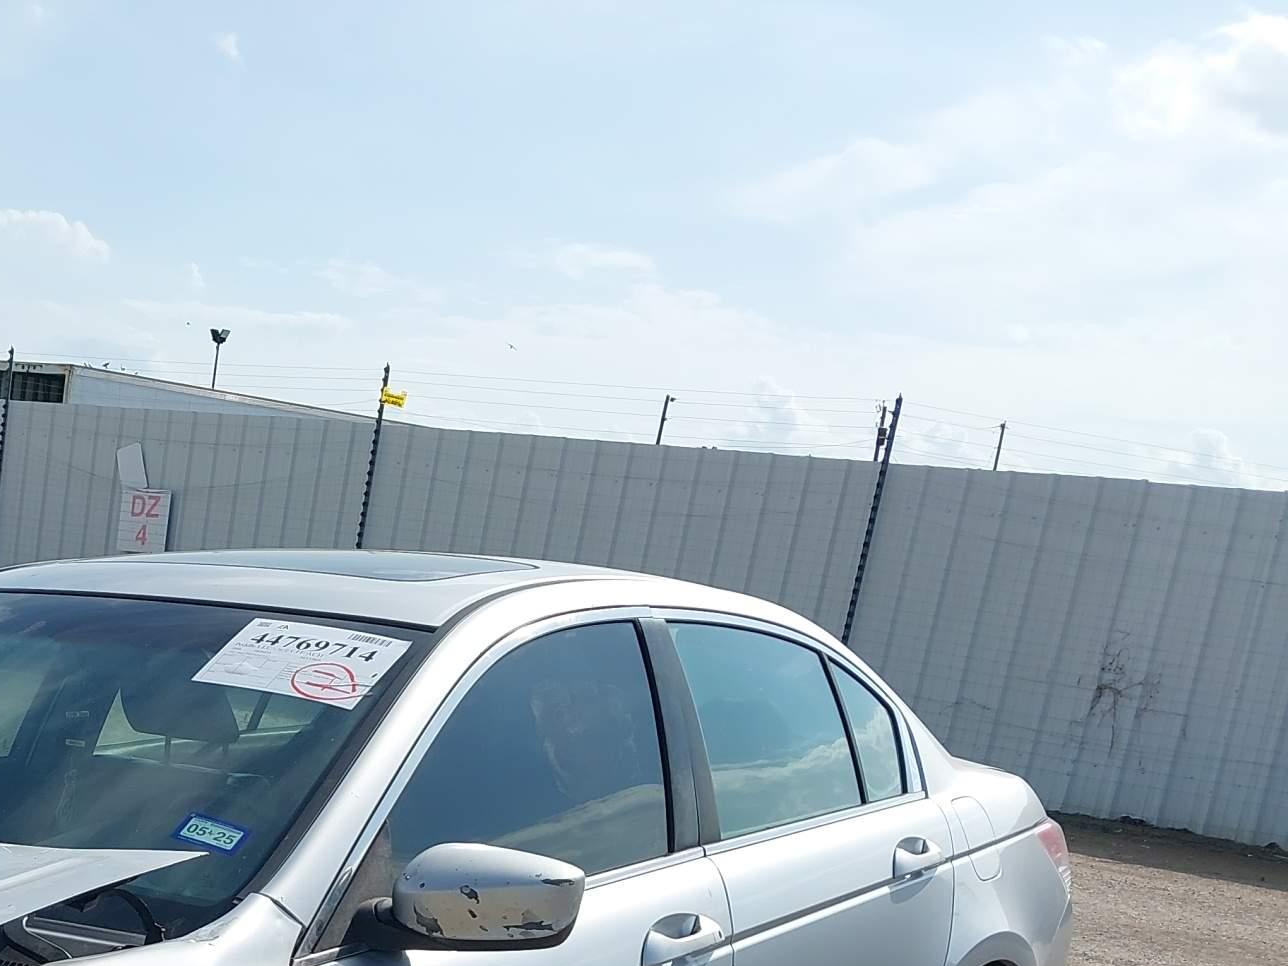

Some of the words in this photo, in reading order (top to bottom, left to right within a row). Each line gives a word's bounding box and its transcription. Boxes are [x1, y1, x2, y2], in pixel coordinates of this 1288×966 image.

[131, 495, 161, 518] DZ
[135, 524, 148, 546] 4
[250, 632, 378, 662] 44769714
